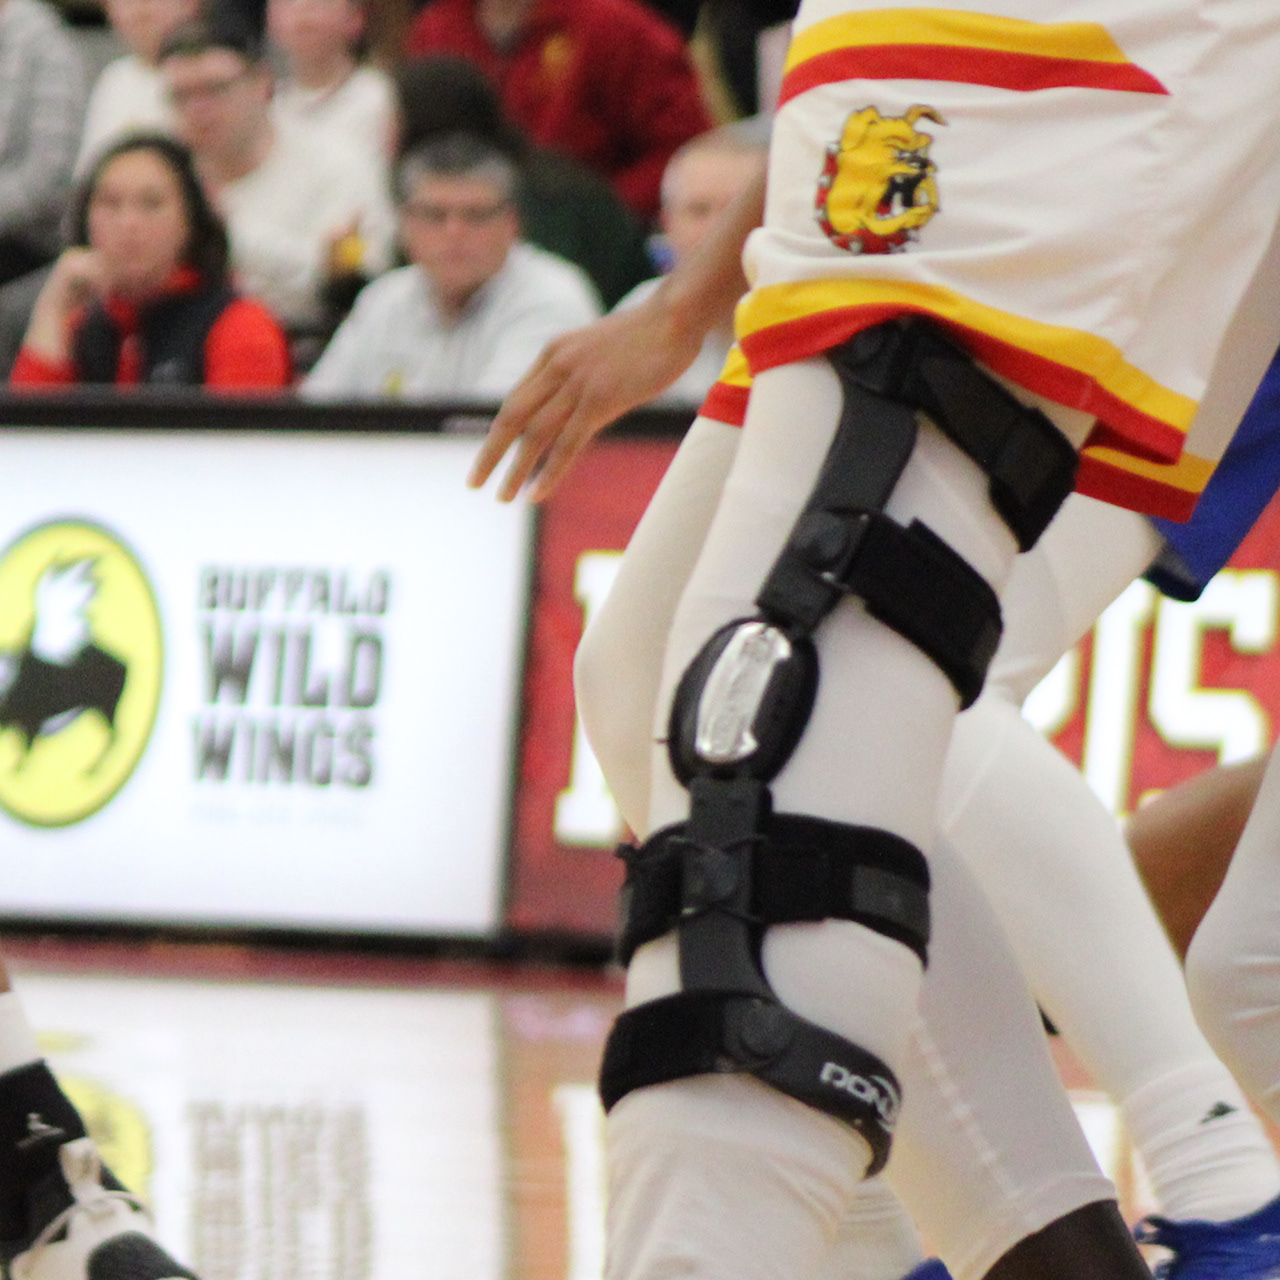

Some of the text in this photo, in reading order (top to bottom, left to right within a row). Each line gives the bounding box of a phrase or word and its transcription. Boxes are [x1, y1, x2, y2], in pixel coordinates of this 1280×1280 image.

[198, 566, 391, 616] BUFFALO
[199, 622, 385, 710] WILD
[191, 718, 376, 789] WINGS
